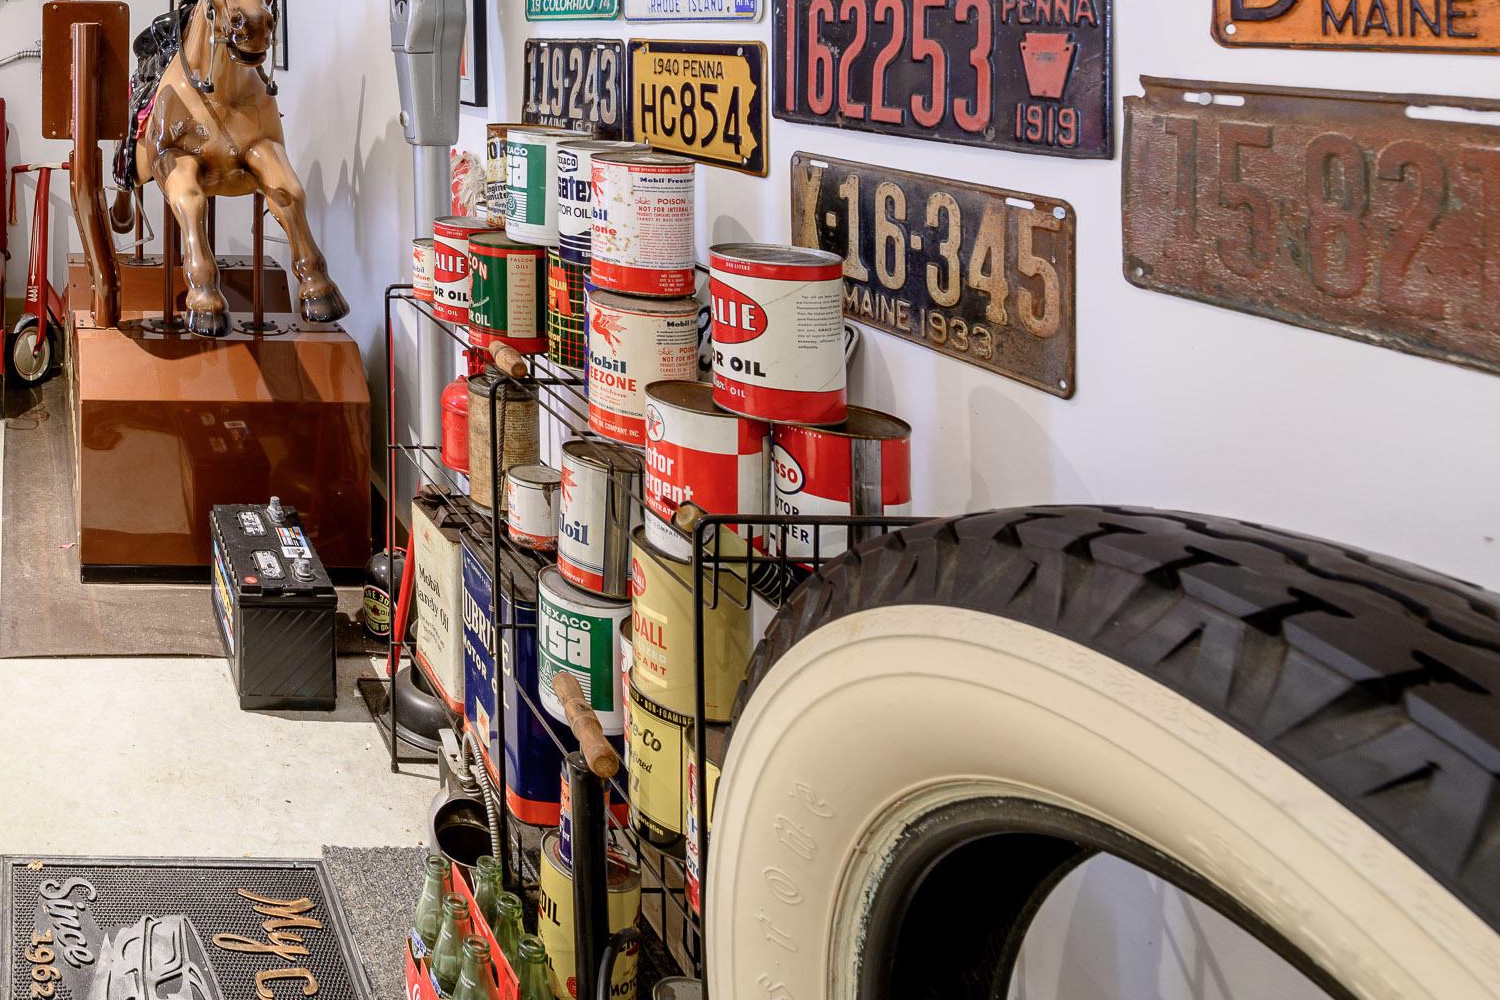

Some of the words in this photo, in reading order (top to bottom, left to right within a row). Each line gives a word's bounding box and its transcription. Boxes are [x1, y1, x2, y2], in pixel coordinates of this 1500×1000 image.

[653, 58, 679, 77] 1940
[683, 59, 725, 80] PENNA
[640, 82, 743, 155] HC854
[1016, 103, 1080, 147] 1919
[573, 207, 592, 219] OIL
[447, 289, 469, 302] OIL
[447, 308, 458, 317] OIL
[475, 312, 491, 327] OIL
[842, 279, 911, 332] MAINE
[920, 310, 993, 361] 1933
[666, 320, 690, 328] Mobil
[730, 356, 767, 378] OIL
[729, 384, 746, 398] OIL
[541, 600, 592, 631] TEXACO
